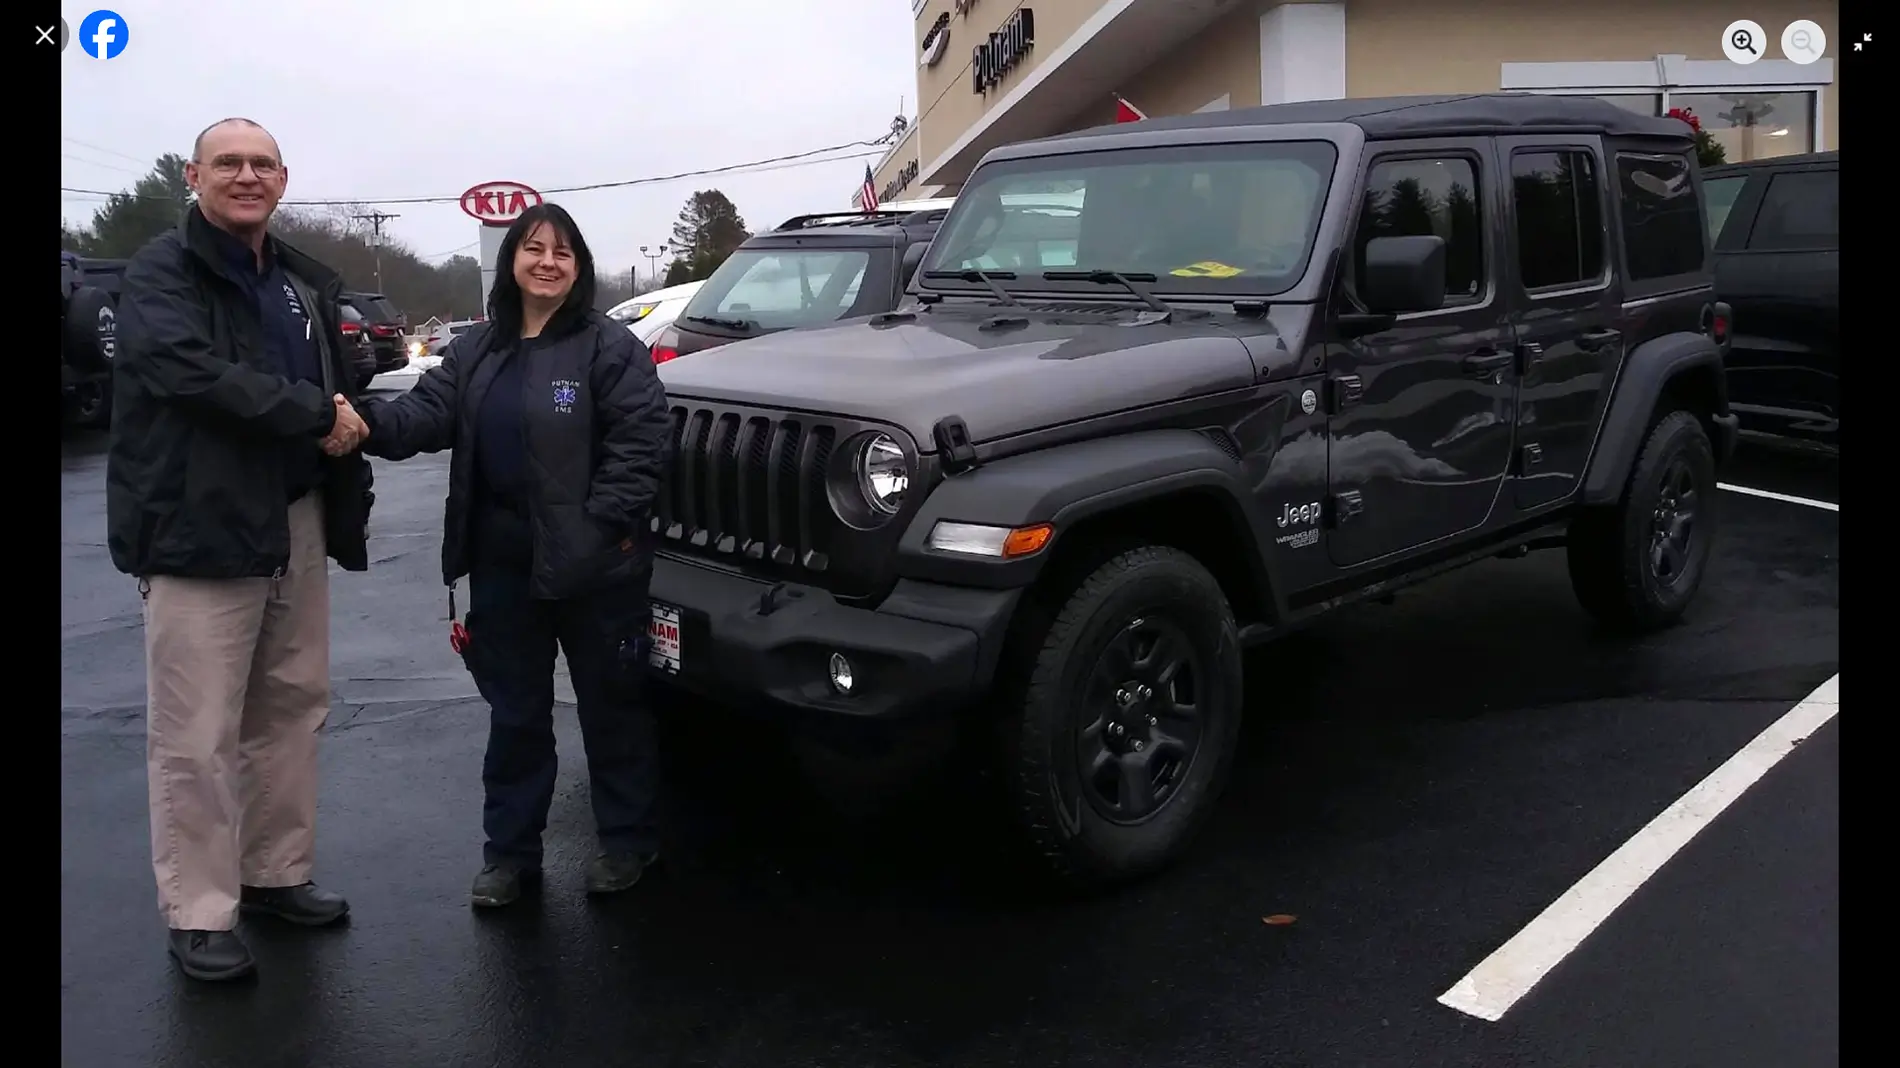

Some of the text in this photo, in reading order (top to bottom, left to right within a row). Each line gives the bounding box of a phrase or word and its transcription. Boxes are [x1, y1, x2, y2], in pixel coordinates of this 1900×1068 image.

[973, 8, 1034, 95] Putnam
[474, 191, 528, 215] KIA
[554, 406, 572, 414] EMS
[1276, 501, 1321, 528] Jeep
